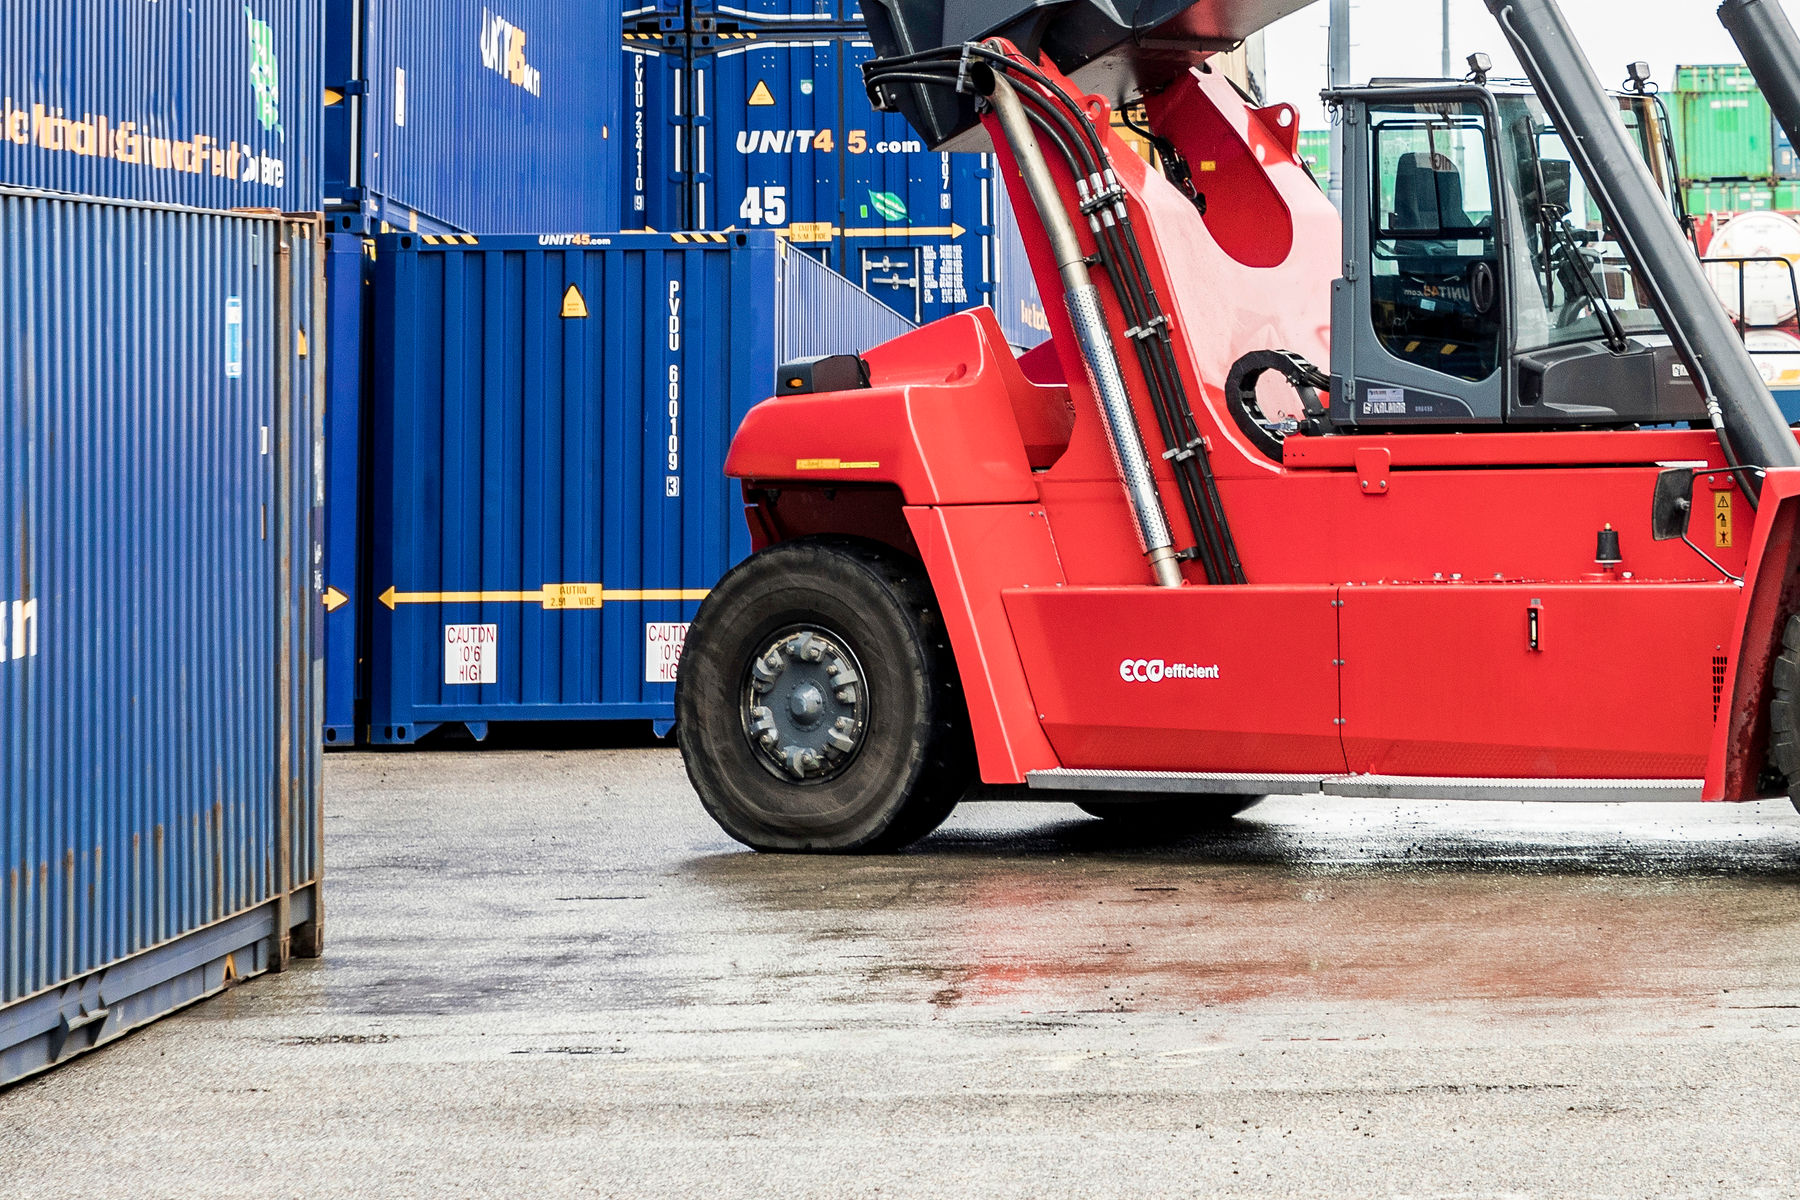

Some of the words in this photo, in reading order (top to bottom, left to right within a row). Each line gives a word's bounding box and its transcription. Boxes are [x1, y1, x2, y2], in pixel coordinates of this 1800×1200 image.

[635, 55, 643, 107] PVDU
[635, 112, 643, 190] 234110
[740, 186, 786, 225] 45
[539, 235, 611, 245] UNIT45.com
[668, 281, 679, 351] PVDU
[668, 365, 678, 470] 600109
[1373, 402, 1406, 414] KALMAR
[1164, 664, 1220, 679] efficient
